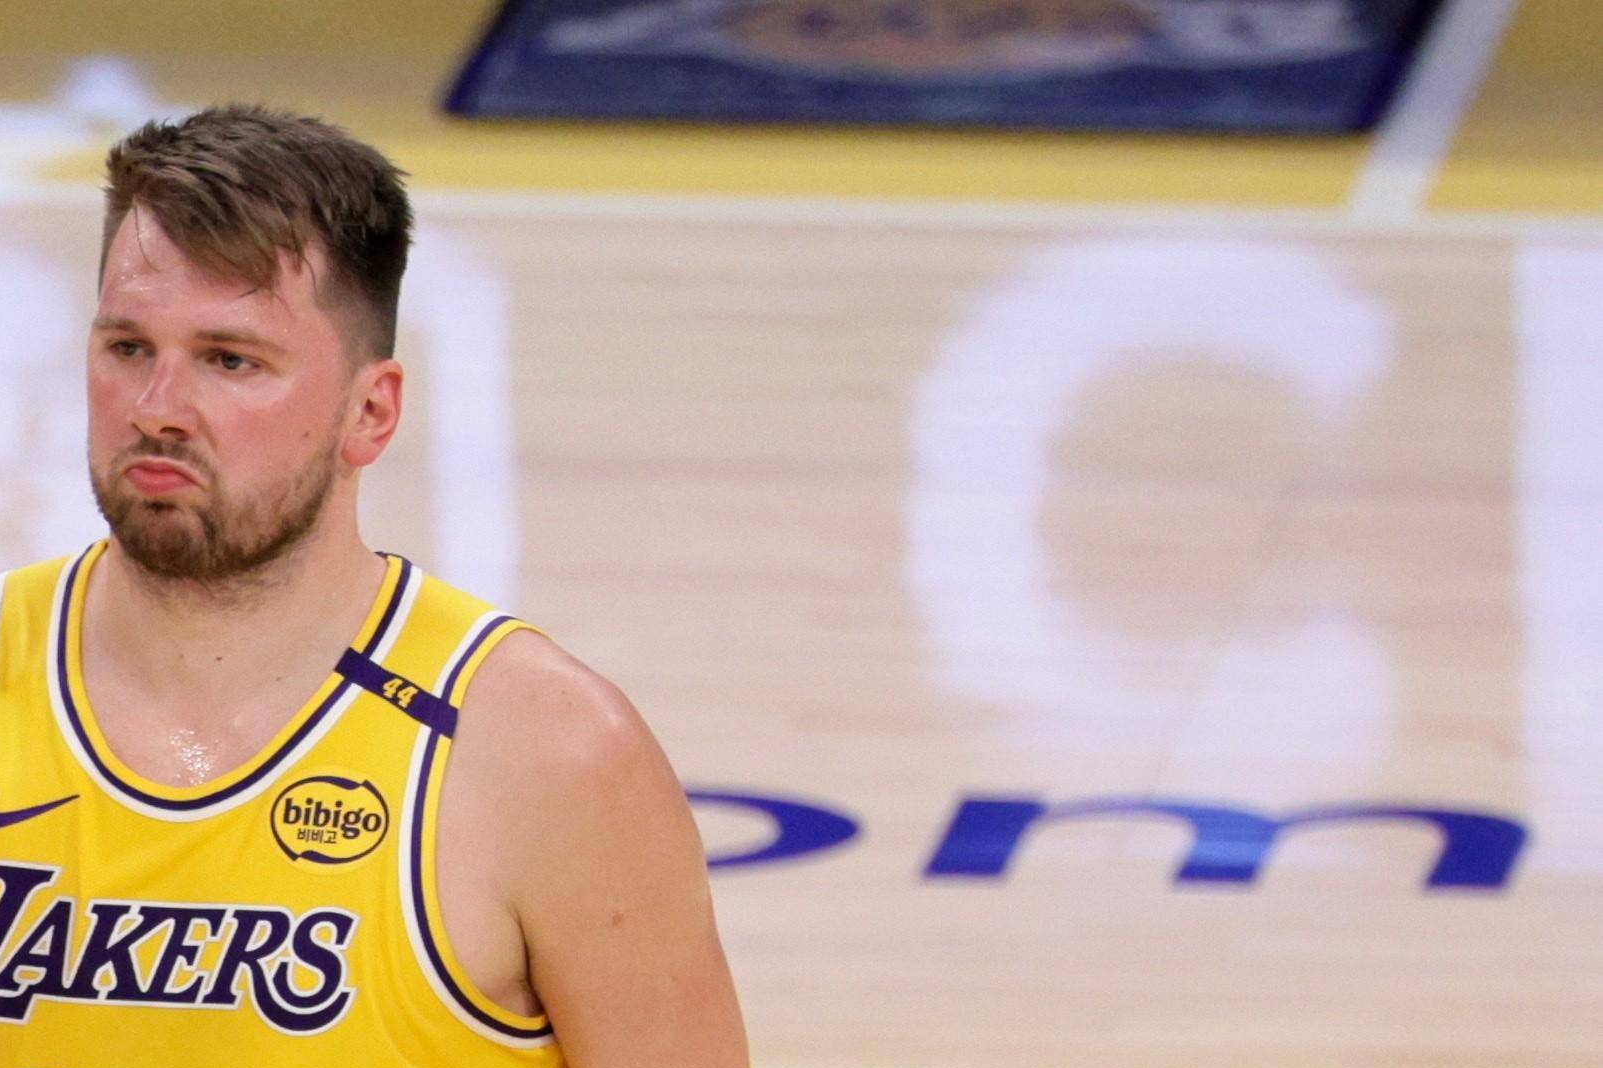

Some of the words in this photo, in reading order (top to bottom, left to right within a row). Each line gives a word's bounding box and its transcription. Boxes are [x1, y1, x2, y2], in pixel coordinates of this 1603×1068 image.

[383, 679, 417, 708] 44
[283, 798, 382, 839] bibigo
[297, 828, 337, 844] 비비고
